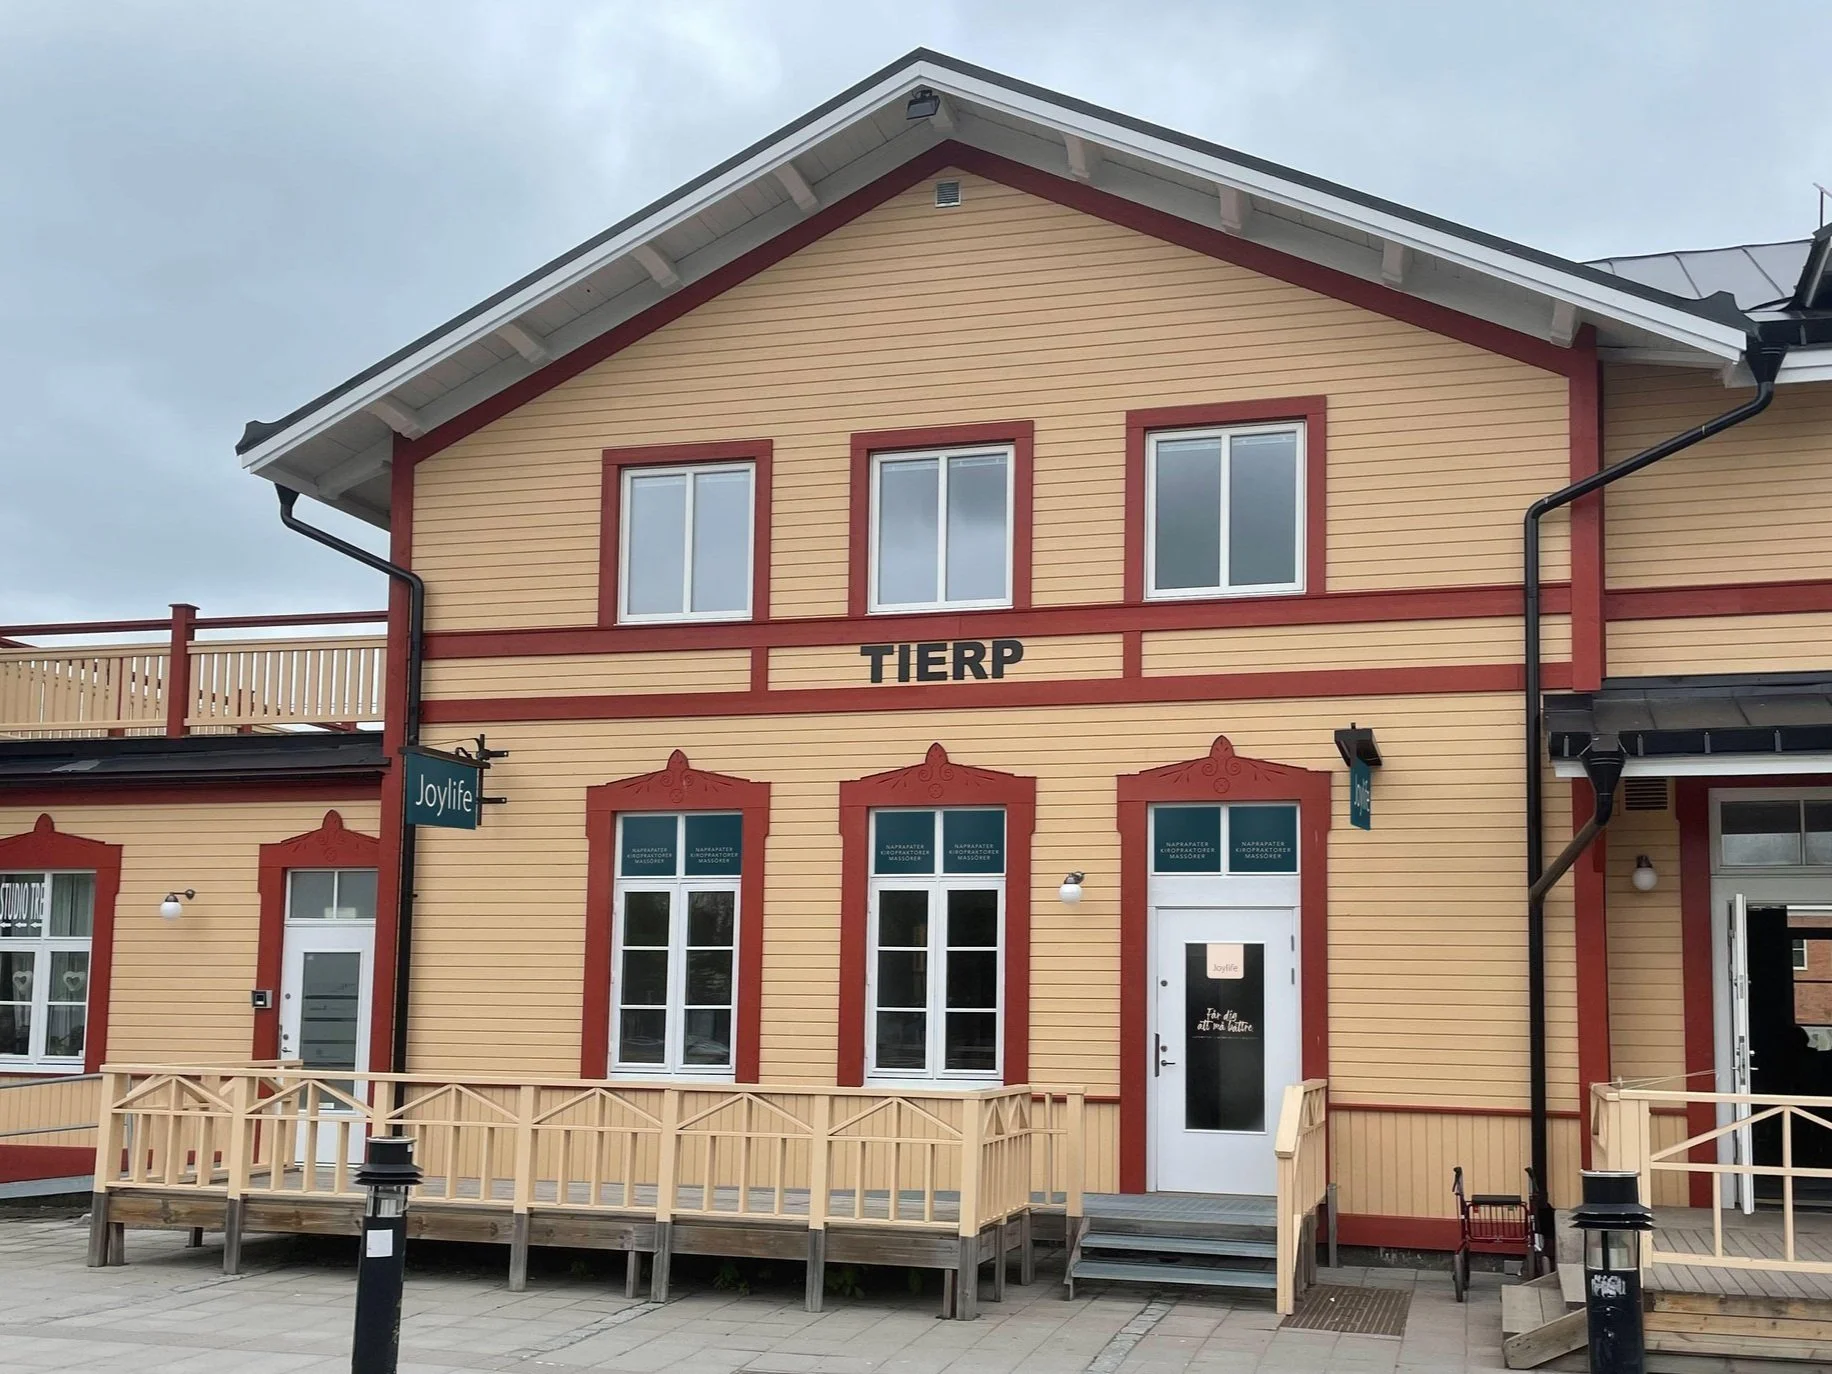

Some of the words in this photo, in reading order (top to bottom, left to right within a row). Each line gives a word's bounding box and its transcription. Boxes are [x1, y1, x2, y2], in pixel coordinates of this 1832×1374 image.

[860, 639, 1024, 684] TIERP
[415, 773, 472, 817] Joylife
[0, 882, 29, 920] STUDIO
[1213, 963, 1239, 974] Joylife
[1196, 1019, 1214, 1031] att
[1206, 1007, 1221, 1021] Får
[1223, 1009, 1238, 1022] dig
